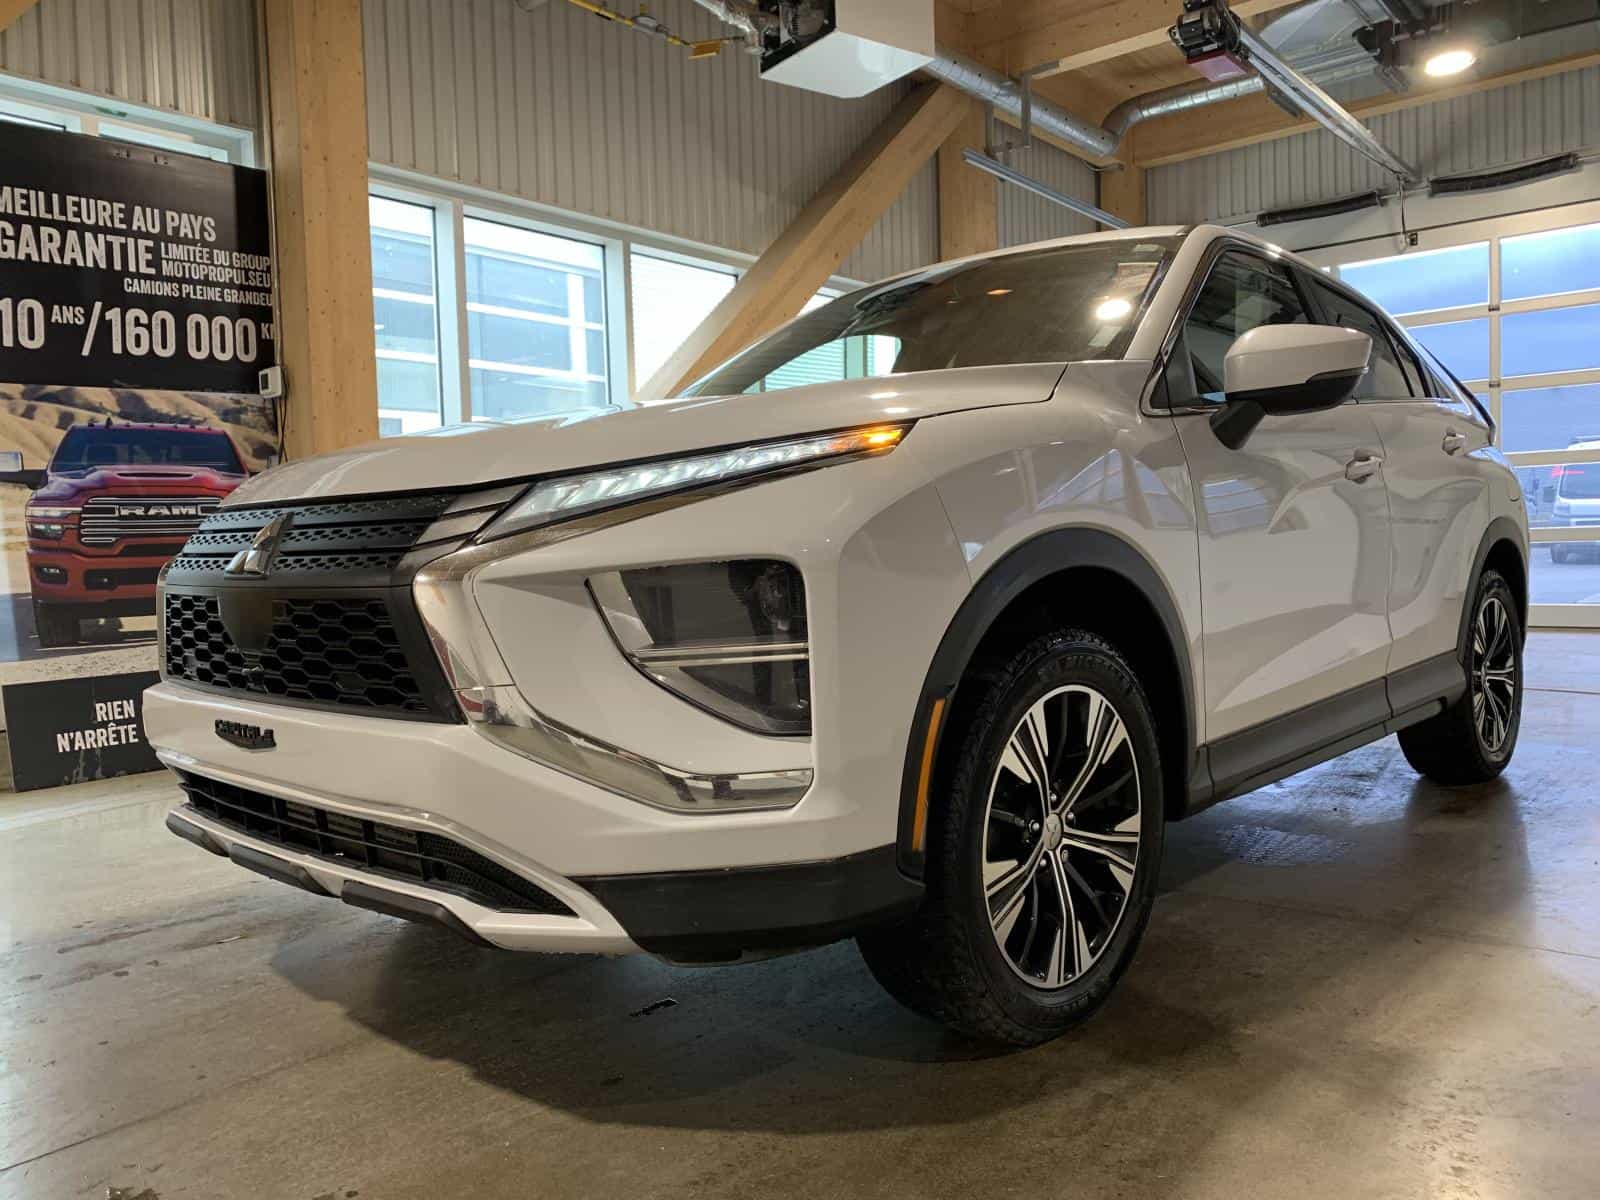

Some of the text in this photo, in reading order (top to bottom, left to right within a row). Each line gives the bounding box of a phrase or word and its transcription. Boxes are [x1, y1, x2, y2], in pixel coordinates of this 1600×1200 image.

[131, 205, 160, 234] AU
[165, 210, 216, 242] PAYS
[0, 220, 156, 275] GARANTIE
[161, 242, 210, 264] LIMITÉE
[213, 250, 230, 266] DU
[124, 277, 179, 298] CAMIONS
[182, 284, 222, 302] PLEINE
[51, 304, 85, 326] ANS
[186, 313, 257, 362] 000
[119, 505, 197, 516] RAM
[95, 699, 135, 722] RIEN
[56, 722, 139, 753] N'ARRÊTE
